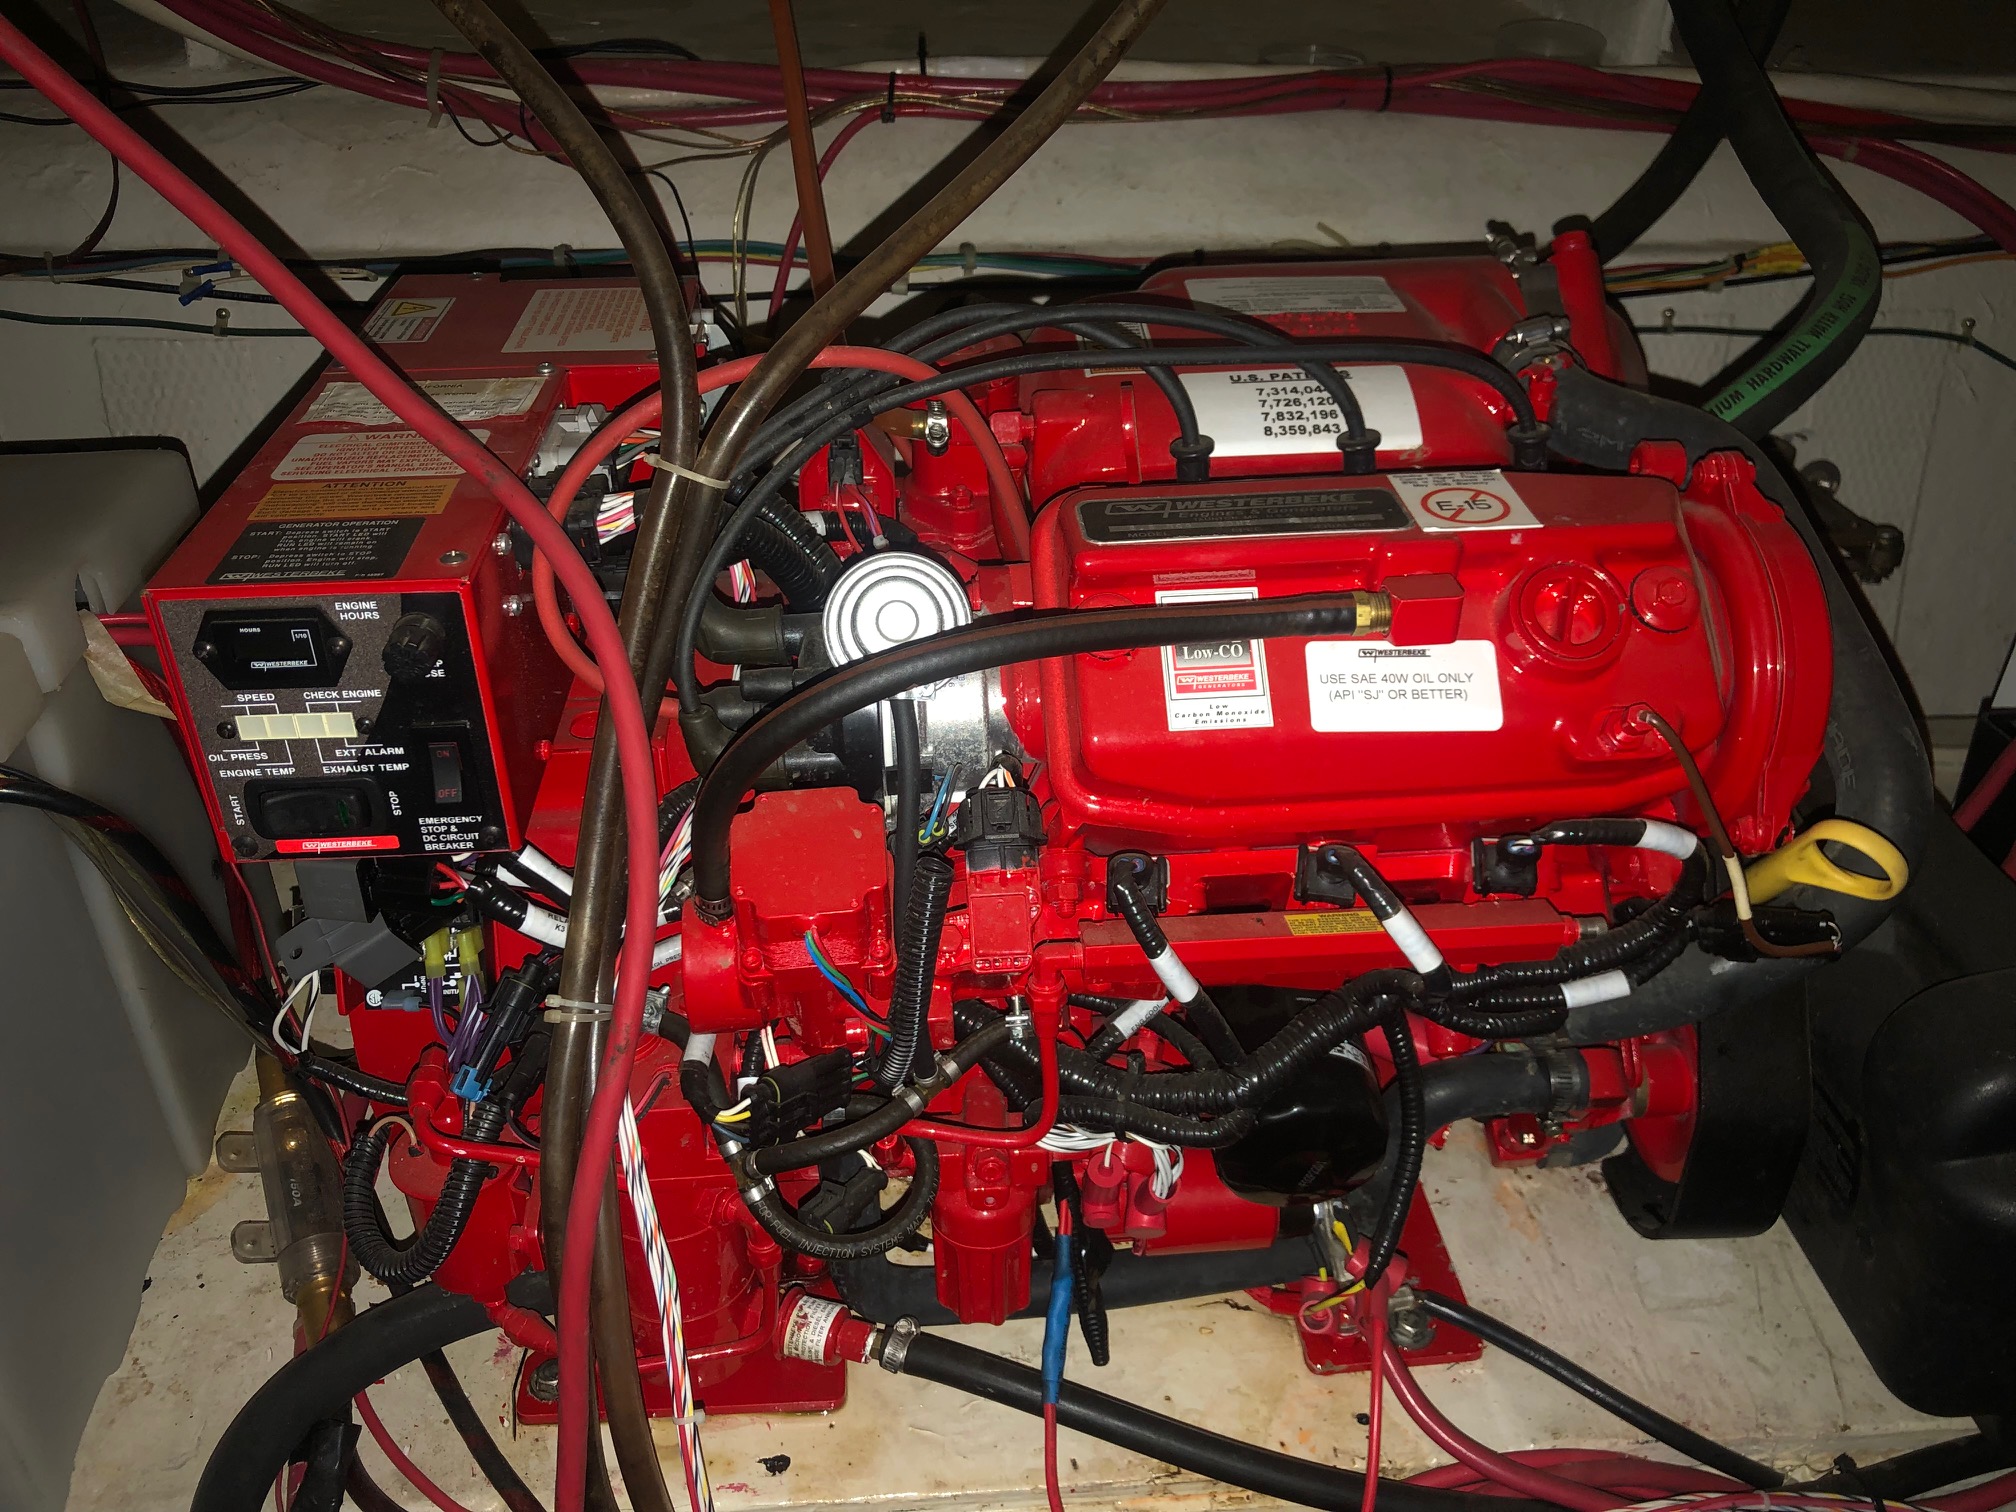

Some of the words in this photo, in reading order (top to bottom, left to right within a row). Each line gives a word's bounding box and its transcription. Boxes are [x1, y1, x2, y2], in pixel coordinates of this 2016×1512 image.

[1746, 339, 1812, 391] HARDWALL
[1809, 311, 1840, 340] WATER
[1229, 373, 1264, 382] U.S.
[1258, 396, 1336, 410] 7,726,120
[1261, 410, 1339, 424] 7,832,196
[1264, 423, 1341, 438] 8,359,843
[365, 432, 422, 440] WARN
[370, 439, 429, 447] COMPONEN
[291, 455, 350, 463] UNAUTHORIZED
[351, 453, 434, 462] REPLACEMENT
[333, 467, 391, 475] ELECTRICAL
[322, 480, 407, 489] ATTENTION
[1176, 492, 1357, 509] WESTERBEKE
[1436, 499, 1492, 512] E-15
[279, 521, 339, 529] GENERATOR
[342, 519, 399, 527] OPERATION
[250, 570, 346, 578] WESTERBEKE
[335, 601, 378, 611] ENGINE
[340, 611, 380, 620] HOURS
[266, 659, 308, 667] WESTERBEKE
[1197, 673, 1250, 682] WESTERBEKE
[1319, 674, 1346, 684] USE
[1350, 673, 1378, 684] SAE
[1381, 673, 1409, 684] 40W
[1412, 673, 1435, 684] OIL
[1437, 672, 1474, 684] ONLY
[1197, 682, 1246, 690] GENERATORS
[236, 692, 275, 702] SPEED
[303, 690, 340, 699] CHECK
[342, 689, 382, 699] ENGINE
[1328, 690, 1355, 702] (API
[1358, 689, 1384, 700] "SJ"
[1387, 689, 1408, 700] OR
[1411, 688, 1469, 702] BETTER)
[1174, 711, 1211, 719] Carbon
[1216, 708, 1266, 717] Monoxide
[1194, 717, 1247, 725] Emissions
[208, 753, 228, 762] OIL
[230, 752, 268, 761] PRESS
[335, 747, 362, 757] EXT.
[365, 747, 405, 756] ALARM
[436, 750, 450, 758] ON
[219, 768, 262, 778] ENGINE
[265, 767, 296, 776] TEMP
[322, 764, 376, 774] EXHAUST
[379, 763, 410, 773] TEMP
[438, 788, 457, 798] OFF
[388, 790, 402, 816] STOP
[228, 794, 245, 826] START
[418, 815, 483, 825] EMERGENCY
[420, 824, 448, 834] STOP
[450, 824, 458, 832] &
[422, 833, 438, 842] DC
[440, 832, 480, 842] CIRCUIT
[321, 839, 373, 848] WESTERBEKE
[424, 841, 474, 851] BREAKER
[547, 912, 569, 922] RELA
[554, 924, 566, 932] K3
[755, 1200, 774, 1222] FOR
[770, 1221, 792, 1243] FUEL
[798, 1238, 855, 1259] INJECTION
[860, 1233, 905, 1257] SYSTEMS
[906, 1208, 928, 1235] MADE
[815, 1325, 826, 1347] FILTER
